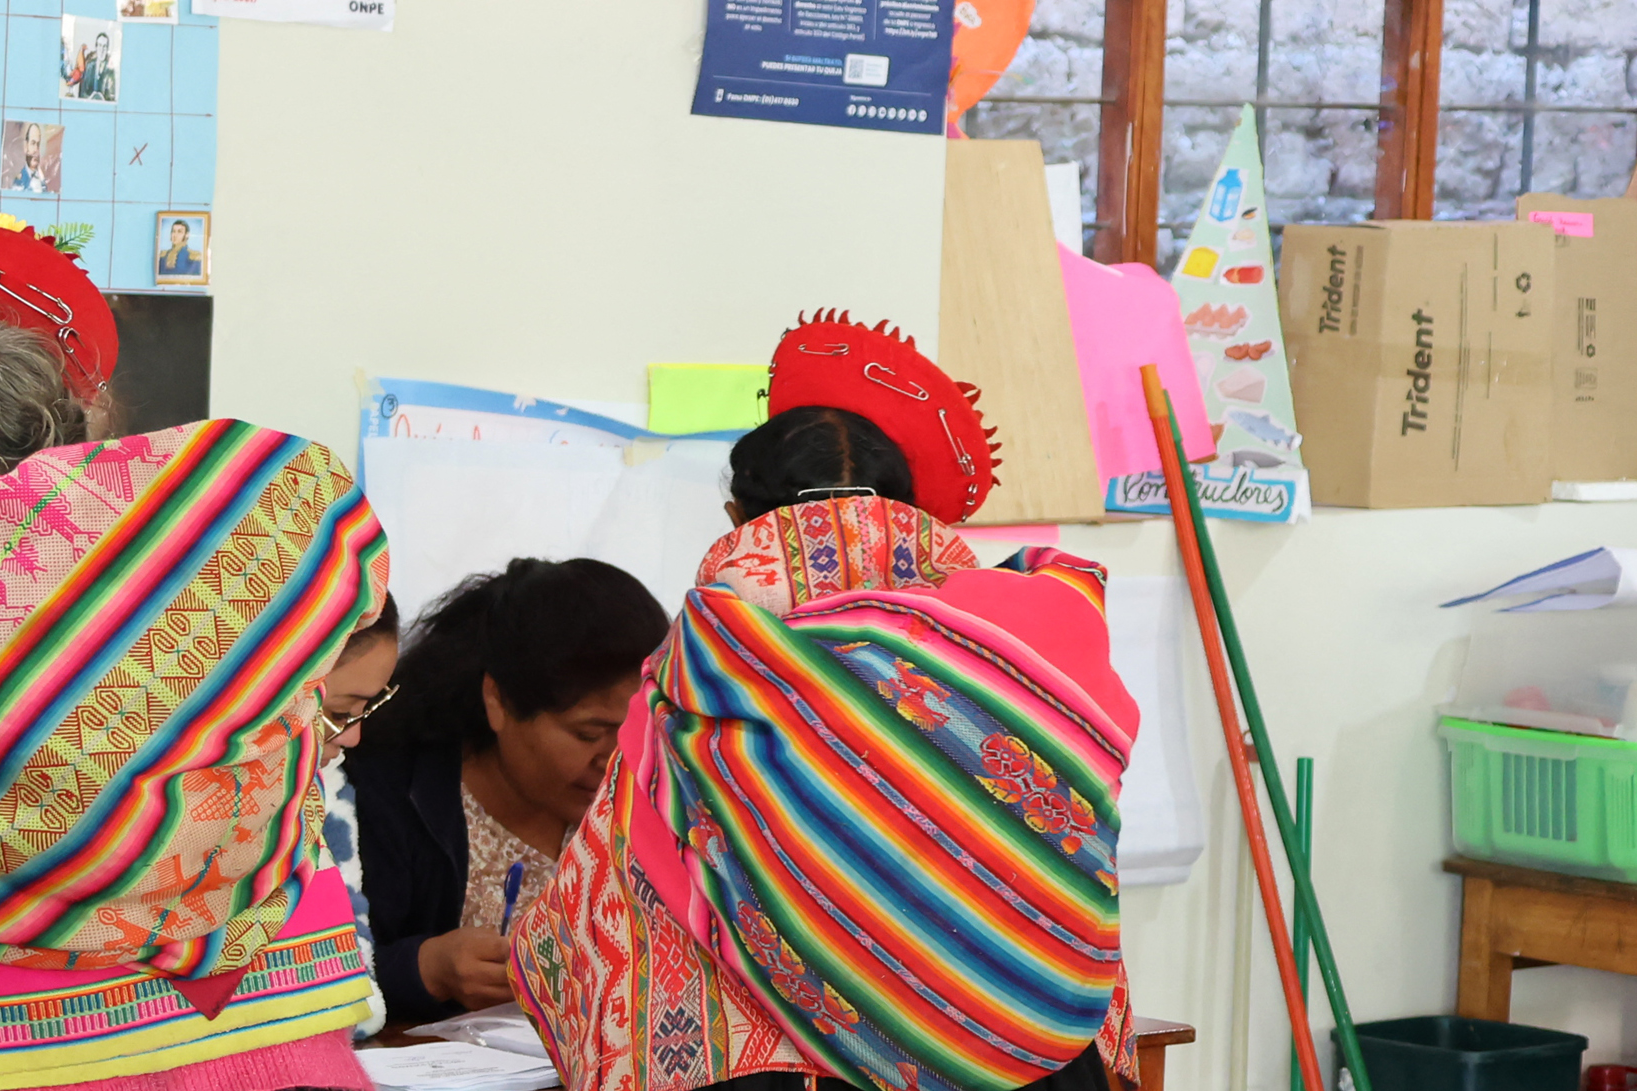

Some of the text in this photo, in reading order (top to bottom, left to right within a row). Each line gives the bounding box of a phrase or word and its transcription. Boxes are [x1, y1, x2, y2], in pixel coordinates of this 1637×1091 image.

[349, 1, 385, 15] ONPE
[1319, 245, 1347, 334] Trident
[1401, 308, 1434, 437] Trident
